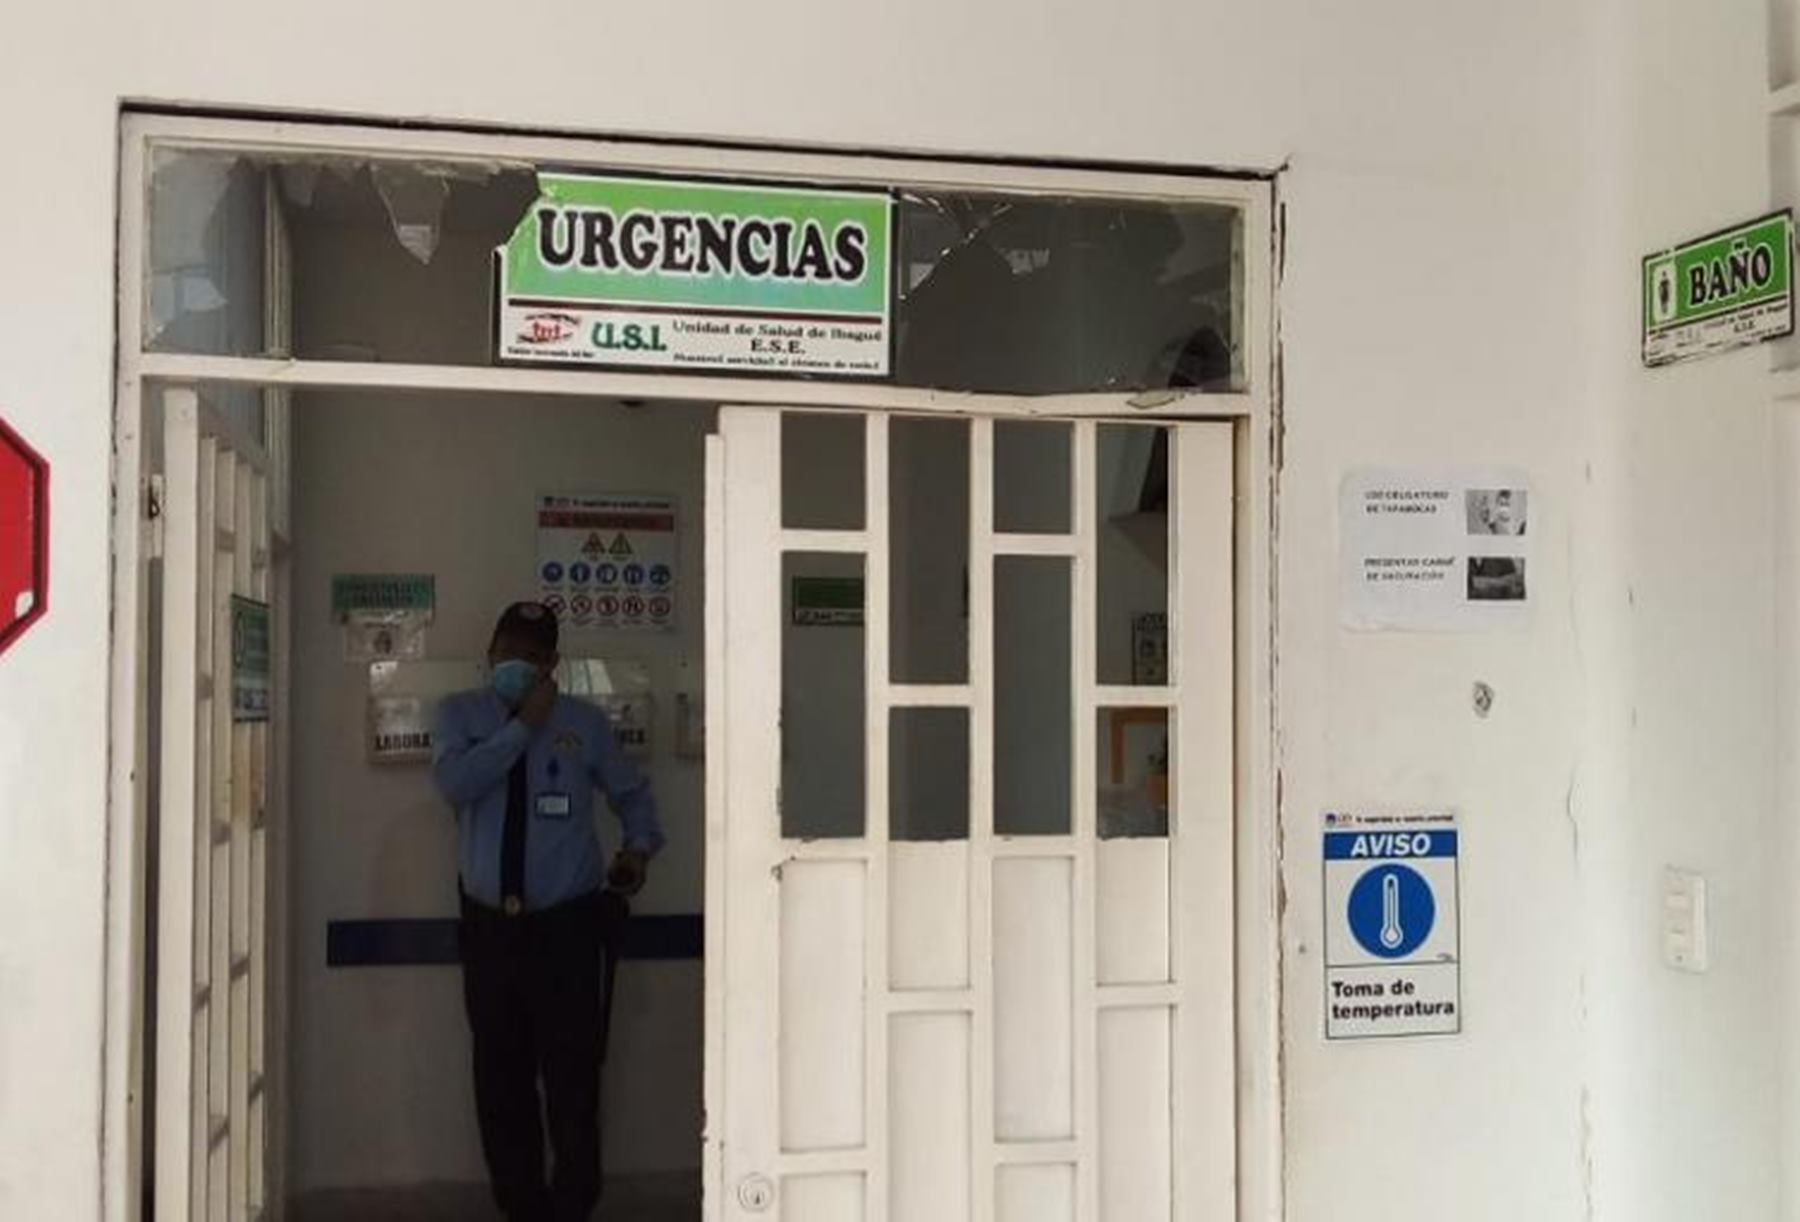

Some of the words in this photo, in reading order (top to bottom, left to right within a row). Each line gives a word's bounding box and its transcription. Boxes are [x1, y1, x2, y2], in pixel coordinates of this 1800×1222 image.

[536, 208, 866, 280] URGENCIAS
[1689, 242, 1772, 306] BAÑO
[672, 319, 730, 336] Unidad
[735, 324, 754, 336] de
[757, 324, 803, 338] Salud
[807, 327, 827, 338] de
[831, 328, 882, 342] Ibagué
[750, 338, 806, 354] E.S.E.
[1351, 832, 1431, 856] AVISO
[1332, 980, 1384, 998] Toma
[1391, 979, 1415, 996] de
[1332, 1001, 1455, 1022] temperatura
